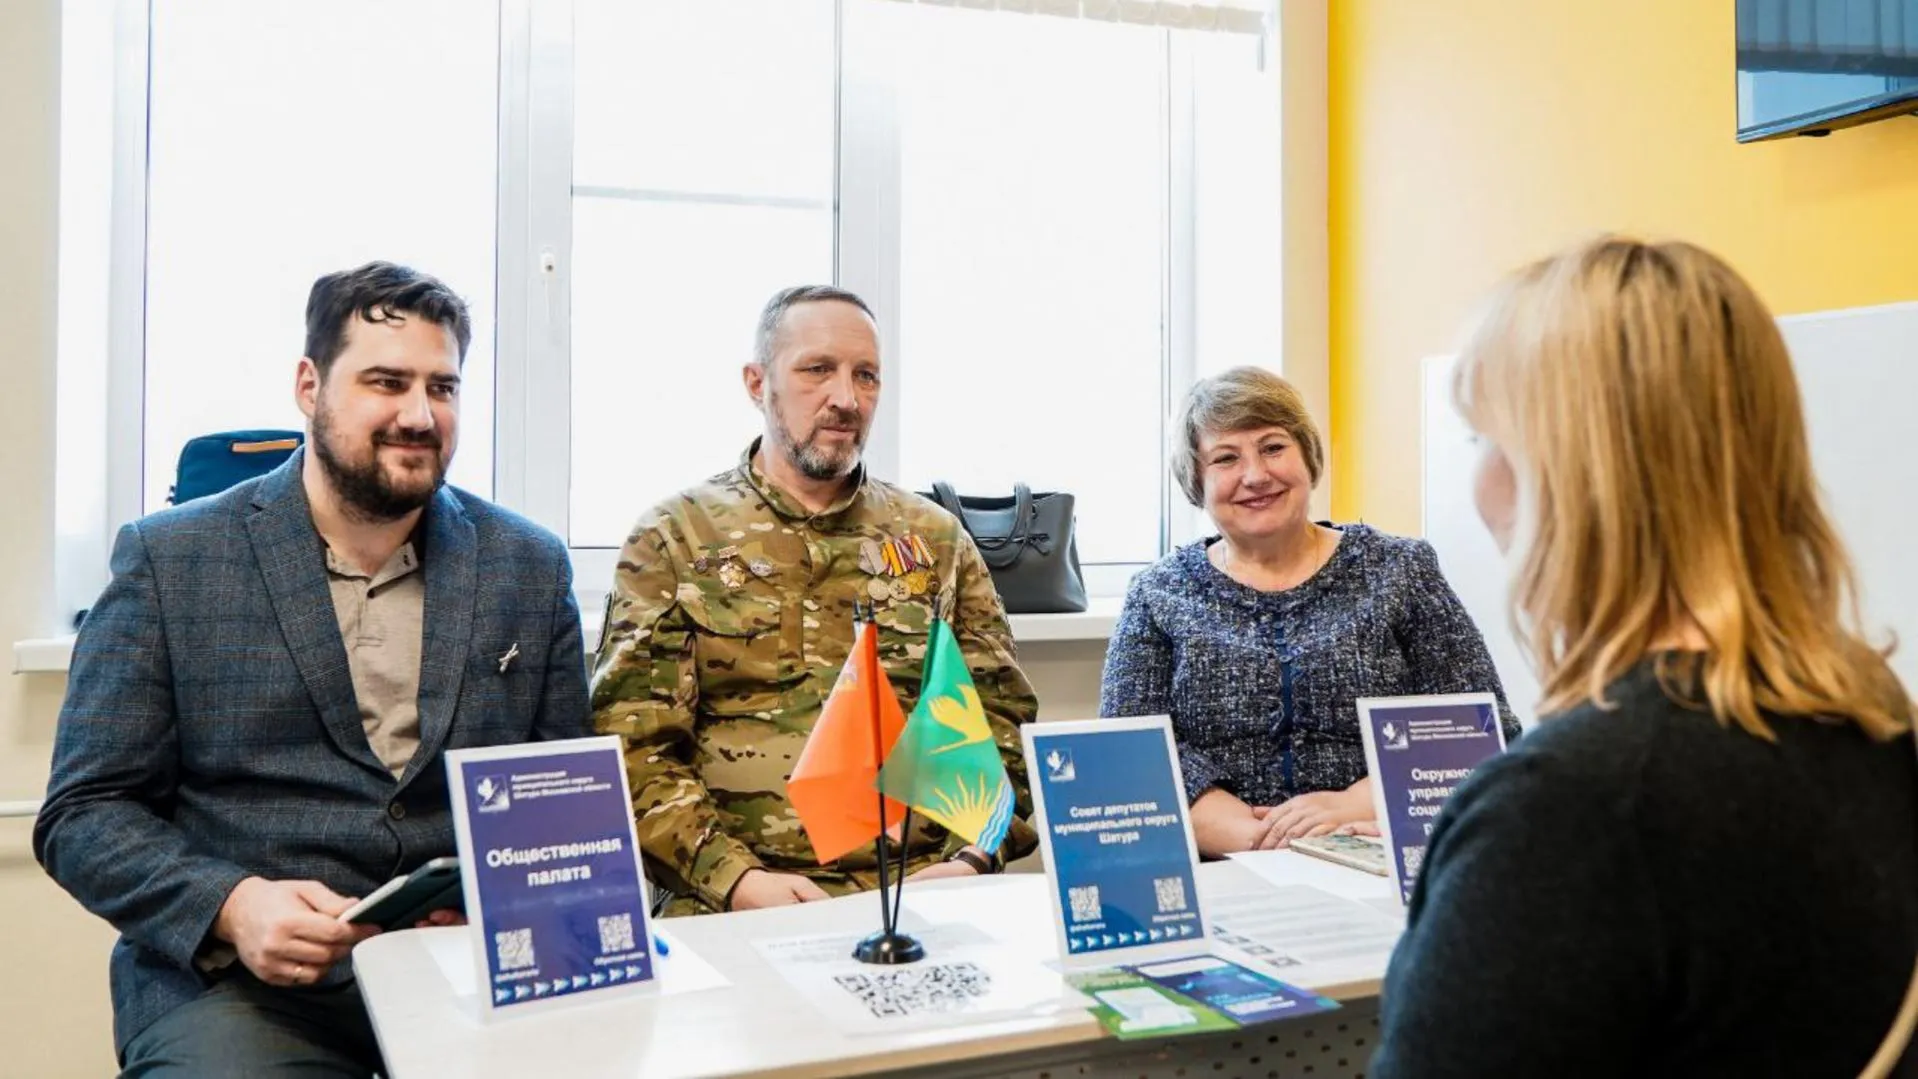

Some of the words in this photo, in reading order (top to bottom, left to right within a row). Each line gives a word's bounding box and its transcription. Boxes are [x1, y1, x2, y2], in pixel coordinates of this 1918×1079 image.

[1069, 805, 1103, 818] Совет
[1104, 801, 1158, 817] депутатов
[1054, 817, 1143, 836] муниципального
[1144, 814, 1179, 828] округа
[486, 837, 622, 867] Общественная
[527, 865, 592, 887] палата
